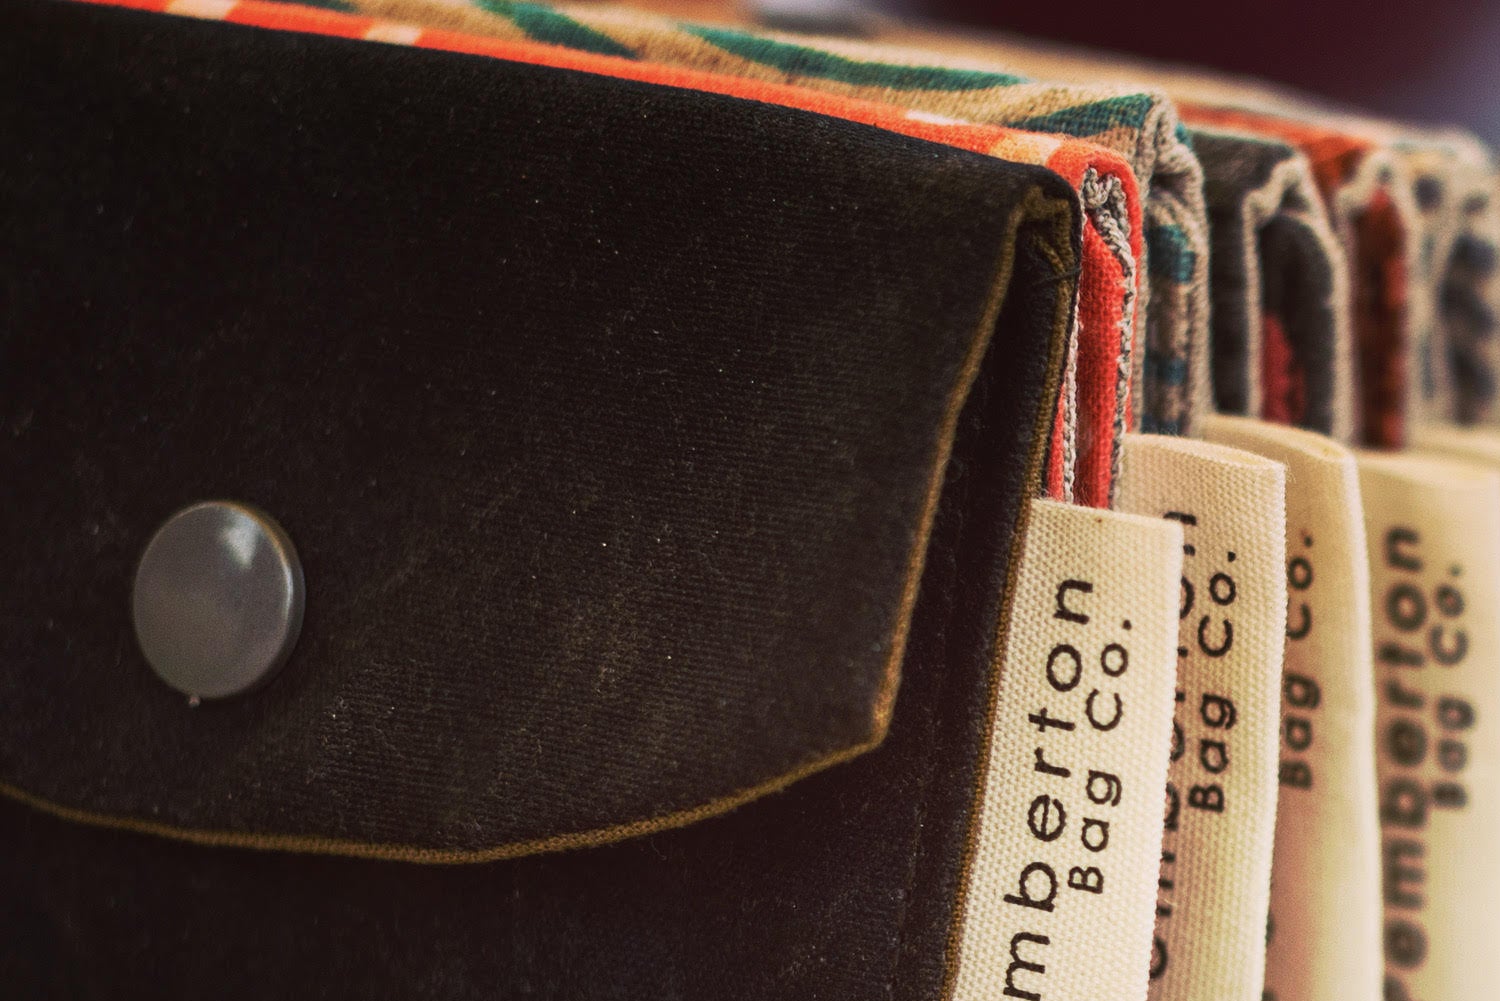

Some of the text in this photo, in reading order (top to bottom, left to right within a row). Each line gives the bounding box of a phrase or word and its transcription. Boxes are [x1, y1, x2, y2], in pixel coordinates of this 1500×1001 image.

[1189, 551, 1237, 813] Bag Co.
[1430, 565, 1468, 666] Co.
[1068, 619, 1132, 894] Bag Co.
[1279, 673, 1321, 789] Bag
